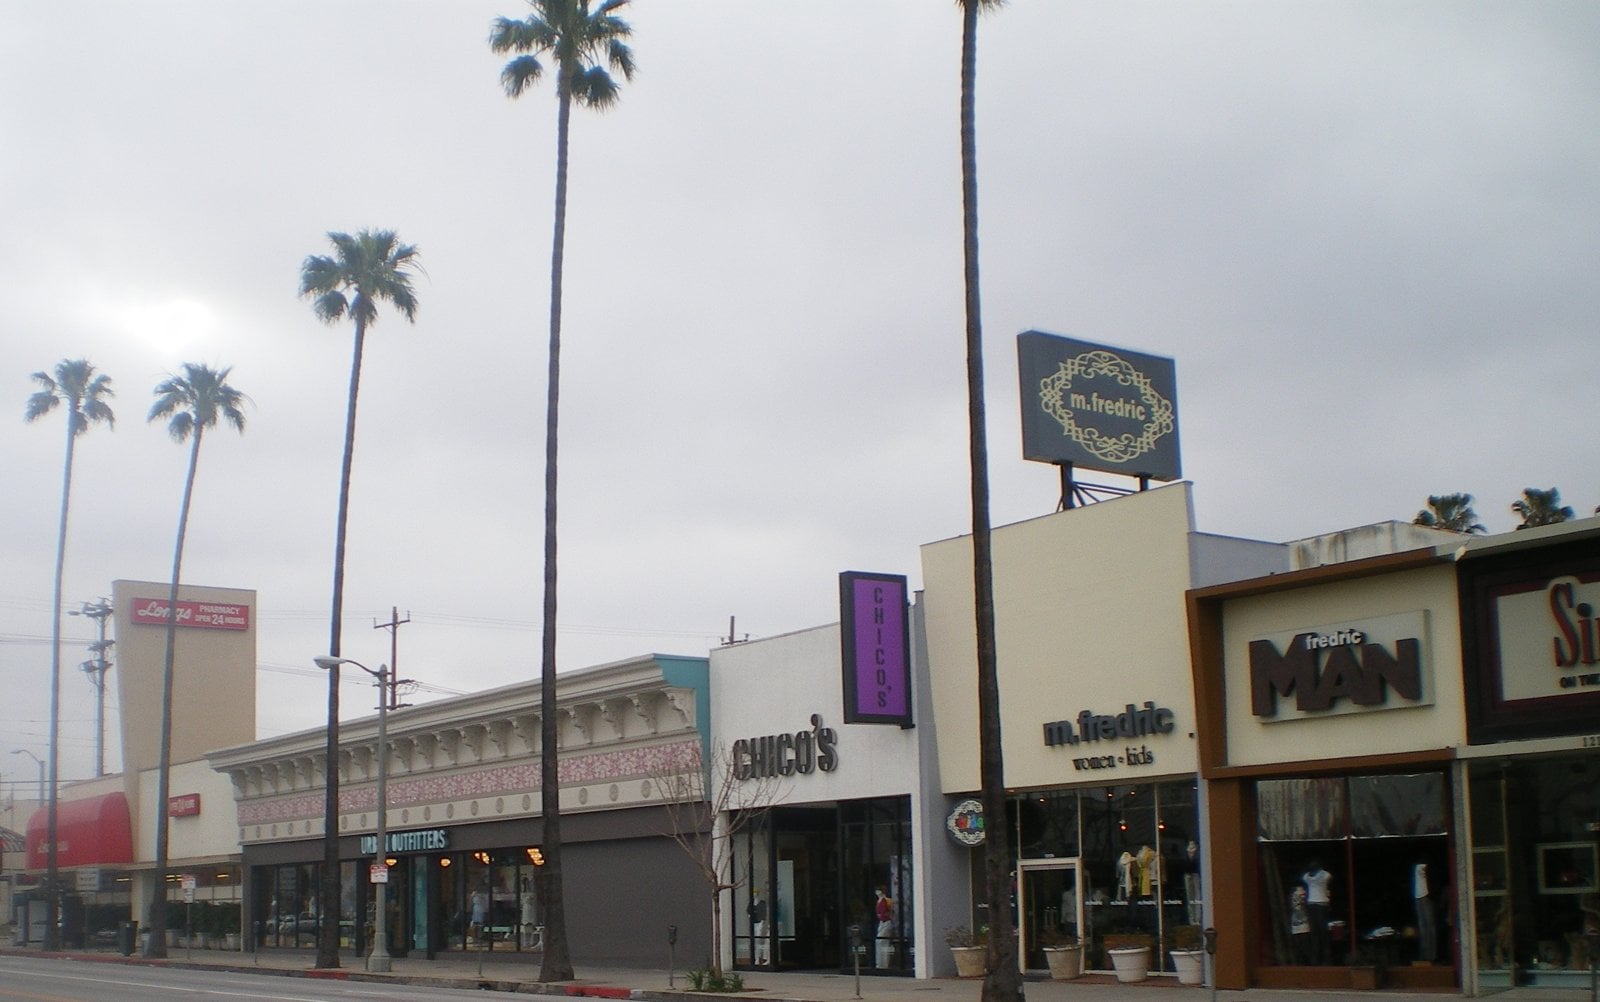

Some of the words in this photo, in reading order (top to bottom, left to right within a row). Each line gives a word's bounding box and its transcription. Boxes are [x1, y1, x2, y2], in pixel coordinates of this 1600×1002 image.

[1070, 392, 1146, 420] m.fredric
[199, 605, 240, 614] PHARMACY
[212, 615, 225, 625] 24
[1550, 583, 1600, 667] Si
[874, 587, 892, 708] CHICO'S
[1306, 630, 1362, 650] fredric
[1249, 632, 1421, 716] MAN
[1043, 701, 1176, 747] m.fredric
[732, 714, 838, 781] CHICO'S
[1125, 744, 1155, 766] kids
[360, 835, 389, 854] URB
[391, 830, 445, 852] OUTFITTERS
